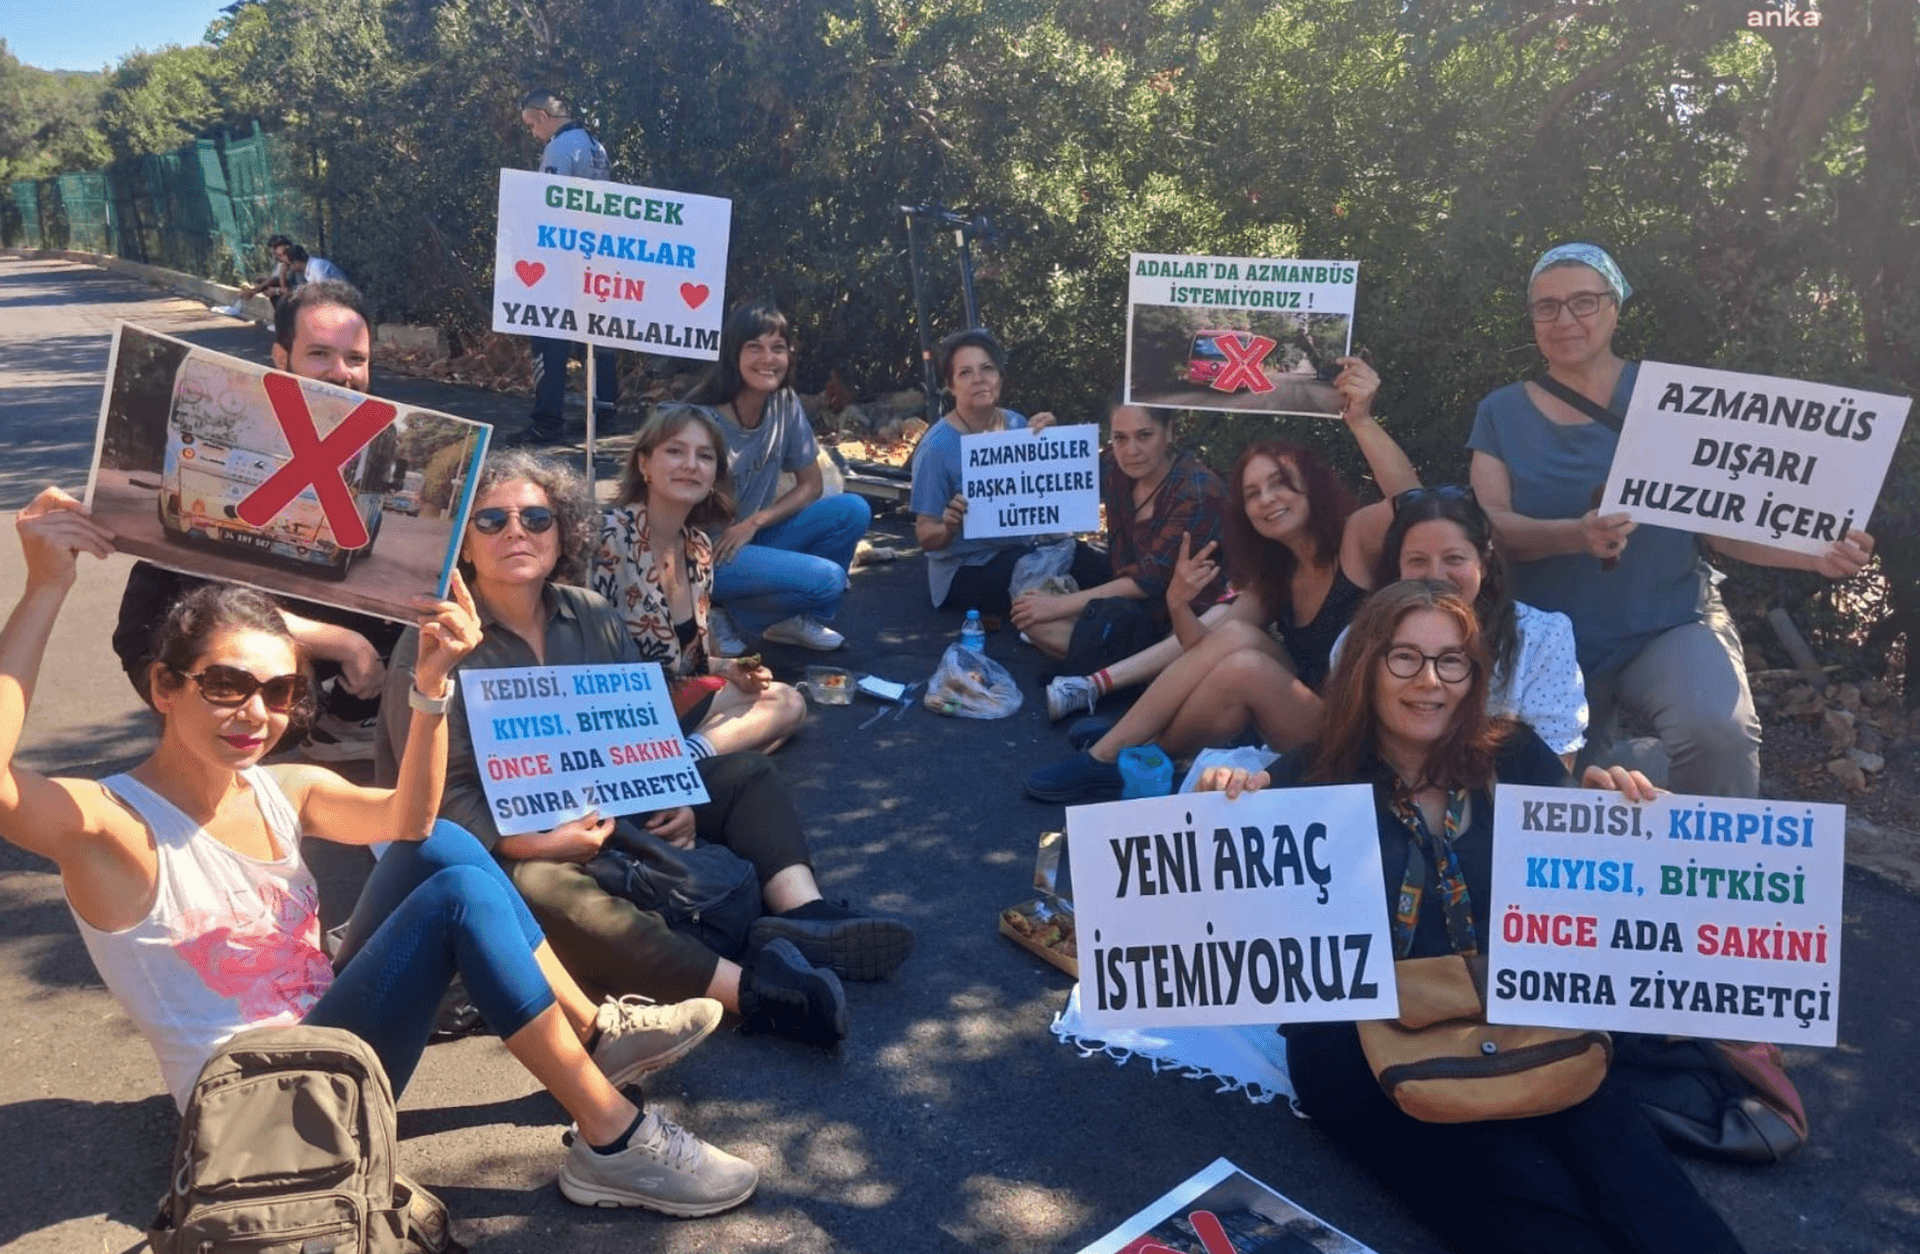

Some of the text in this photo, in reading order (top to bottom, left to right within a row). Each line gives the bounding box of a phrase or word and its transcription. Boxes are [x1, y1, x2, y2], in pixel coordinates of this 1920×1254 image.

[545, 185, 684, 226] GELECEK
[537, 225, 696, 269] KUŞAKLAR
[583, 266, 645, 302] İÇİN
[1135, 260, 1355, 285] ADALAR'DA AZMANBÜS
[1170, 282, 1314, 309] İSTEMİYORUZ !
[502, 301, 720, 351] YAYA KALALIM
[1657, 382, 1876, 441] AZMANBÜS
[969, 437, 1090, 467] AZMANBÜSLER
[1691, 438, 1817, 485] DIŞARI
[967, 470, 1093, 503] BAŞKA İLÇELERE
[1618, 478, 1854, 542] HUZUR İÇERİ
[998, 503, 1059, 527] LÜTFEN
[480, 667, 652, 701] KEDİSİ, KİRPİSİ
[492, 701, 659, 741] KIYISI, BİTKİSİ
[487, 734, 683, 782] ÖNCE ADA SAKİNİ
[496, 766, 700, 819] SONRA ZİYARETÇİ
[1522, 796, 1814, 847] KEDİSİ, KİRPİSİ
[1109, 811, 1332, 905] YENİ ARAÇ
[1526, 857, 1805, 904] KIYISI, BİTKİSİ
[1503, 904, 1827, 963] ÖNCE ADA SAKİNİ
[1094, 921, 1378, 1011] İSTEMİYORUZ
[1496, 969, 1832, 1028] SONRA ZİYARETÇİ
